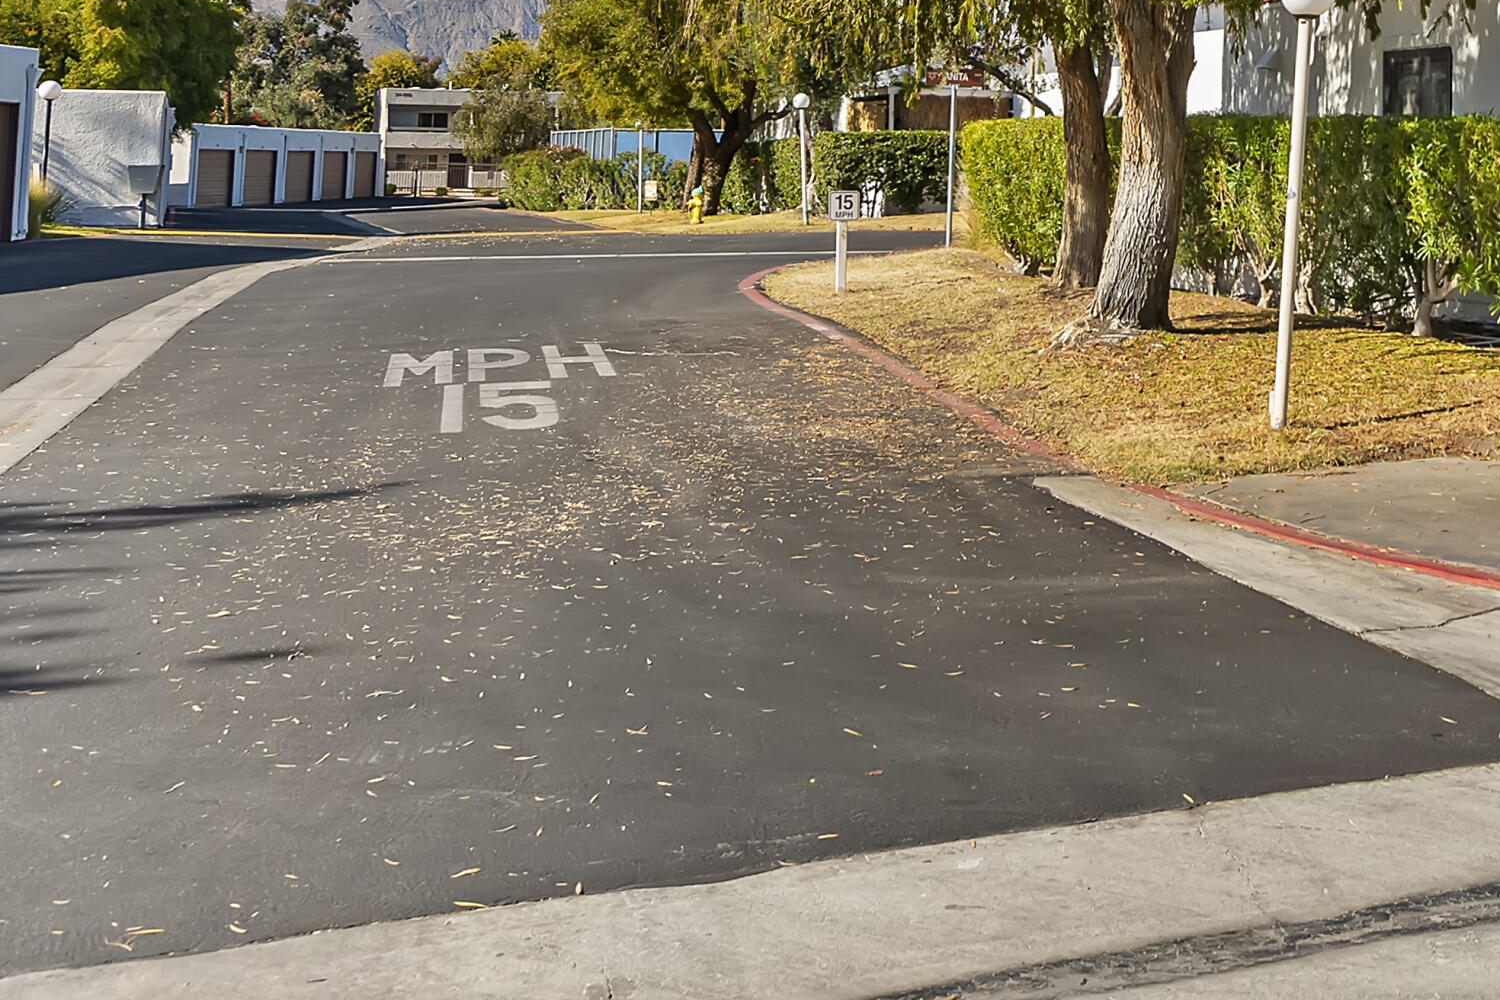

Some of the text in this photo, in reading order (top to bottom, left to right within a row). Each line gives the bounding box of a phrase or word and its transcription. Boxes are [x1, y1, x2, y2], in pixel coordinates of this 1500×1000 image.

[835, 194, 853, 210] 15
[383, 342, 617, 387] MPH
[440, 380, 560, 433] 15
